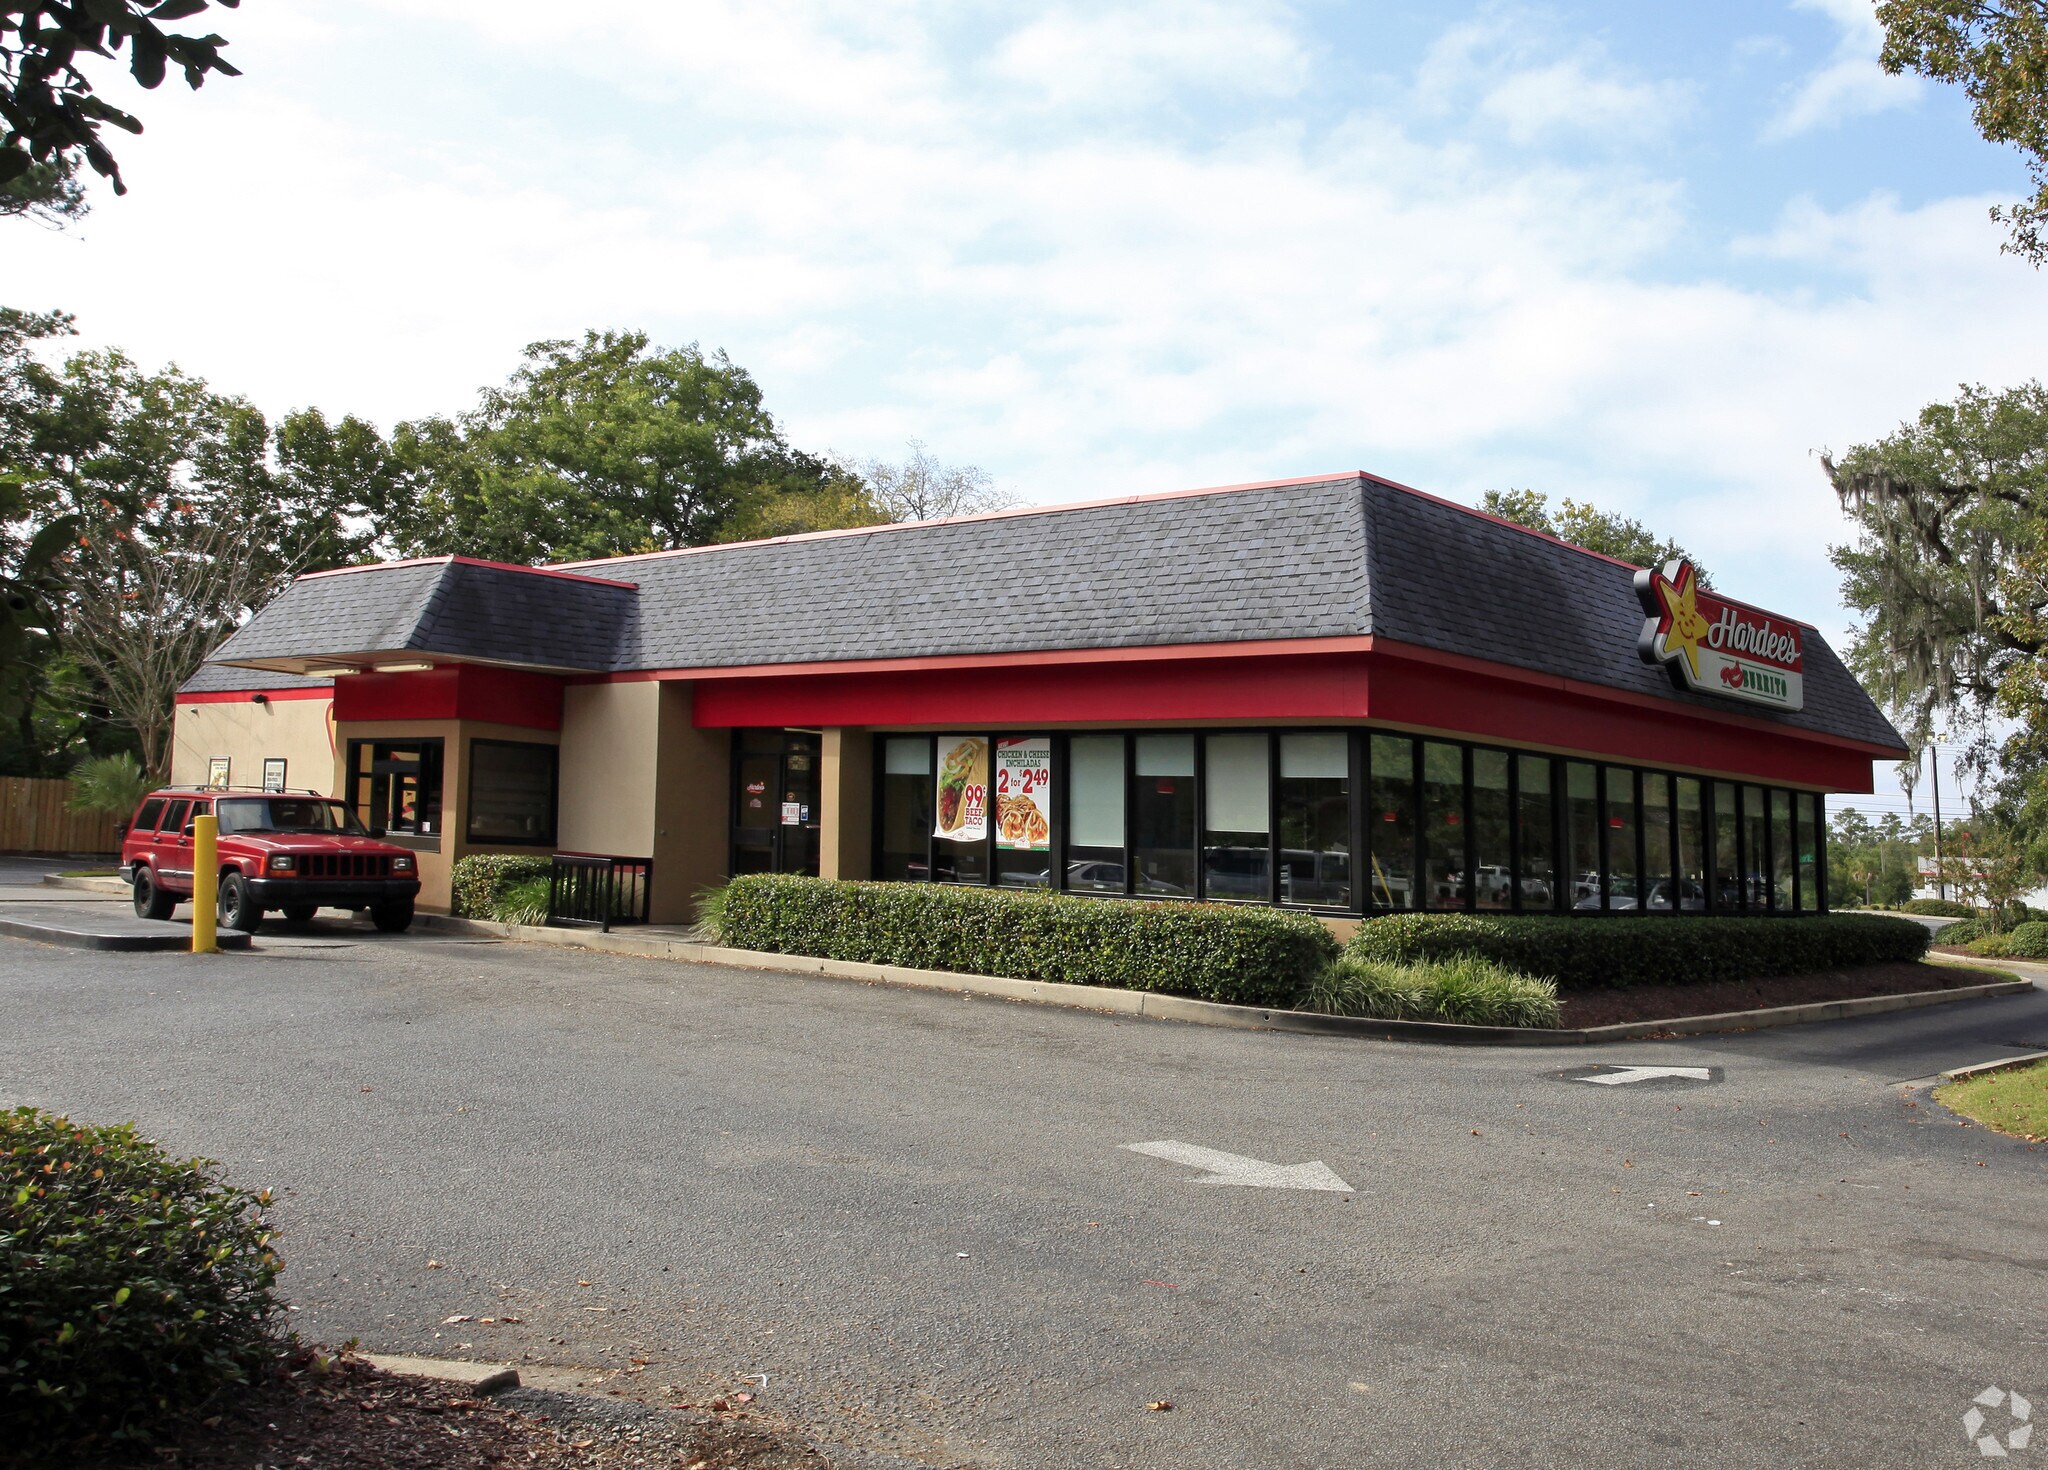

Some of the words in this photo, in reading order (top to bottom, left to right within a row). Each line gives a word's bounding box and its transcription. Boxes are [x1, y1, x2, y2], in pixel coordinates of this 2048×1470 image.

[1708, 607, 1800, 664] Hardee's
[1742, 669, 1787, 697] BURRITO
[998, 750, 1022, 758] CHICKEN
[1023, 750, 1028, 758] &
[1028, 750, 1049, 758] CHEESE
[1006, 759, 1041, 767] ENCHILADAS
[998, 769, 1009, 793] 2
[1011, 777, 1020, 787] for
[966, 808, 982, 816] BEEF
[965, 817, 983, 825] TACO
